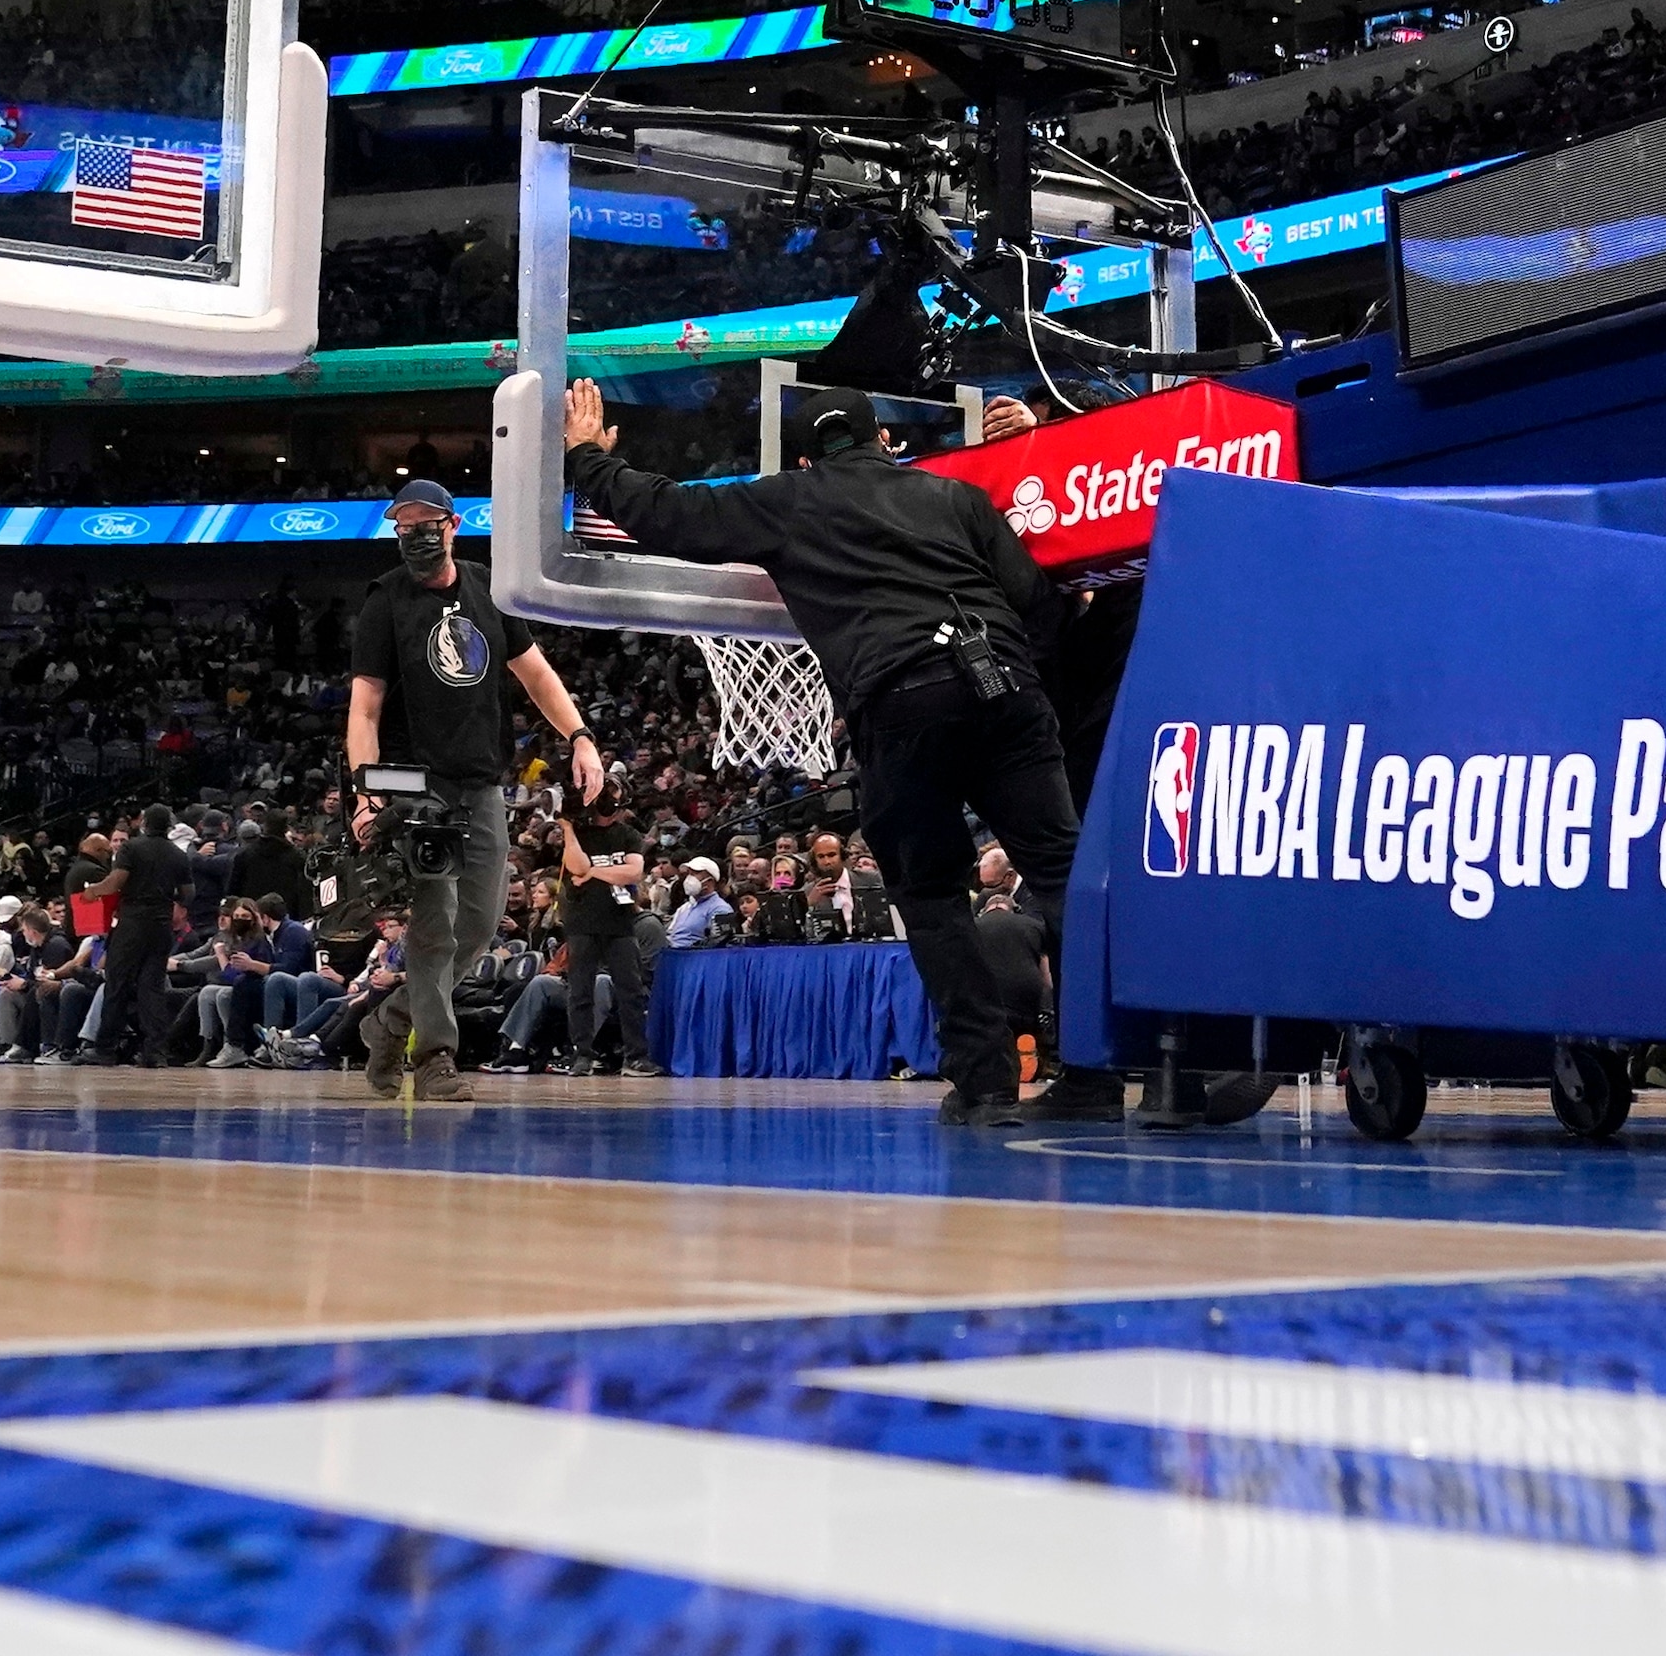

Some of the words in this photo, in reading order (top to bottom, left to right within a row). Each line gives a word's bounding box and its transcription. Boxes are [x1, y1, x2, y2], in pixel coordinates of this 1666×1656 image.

[643, 33, 689, 58] Ford
[439, 53, 483, 79] Ford
[1285, 220, 1335, 243] BEST
[1338, 213, 1358, 233] IN
[1098, 261, 1140, 284] BEST
[1060, 450, 1168, 527] State
[94, 515, 137, 538] Ford
[283, 510, 325, 533] Ford
[1196, 722, 1321, 882] NBA
[1333, 724, 1597, 921] League
